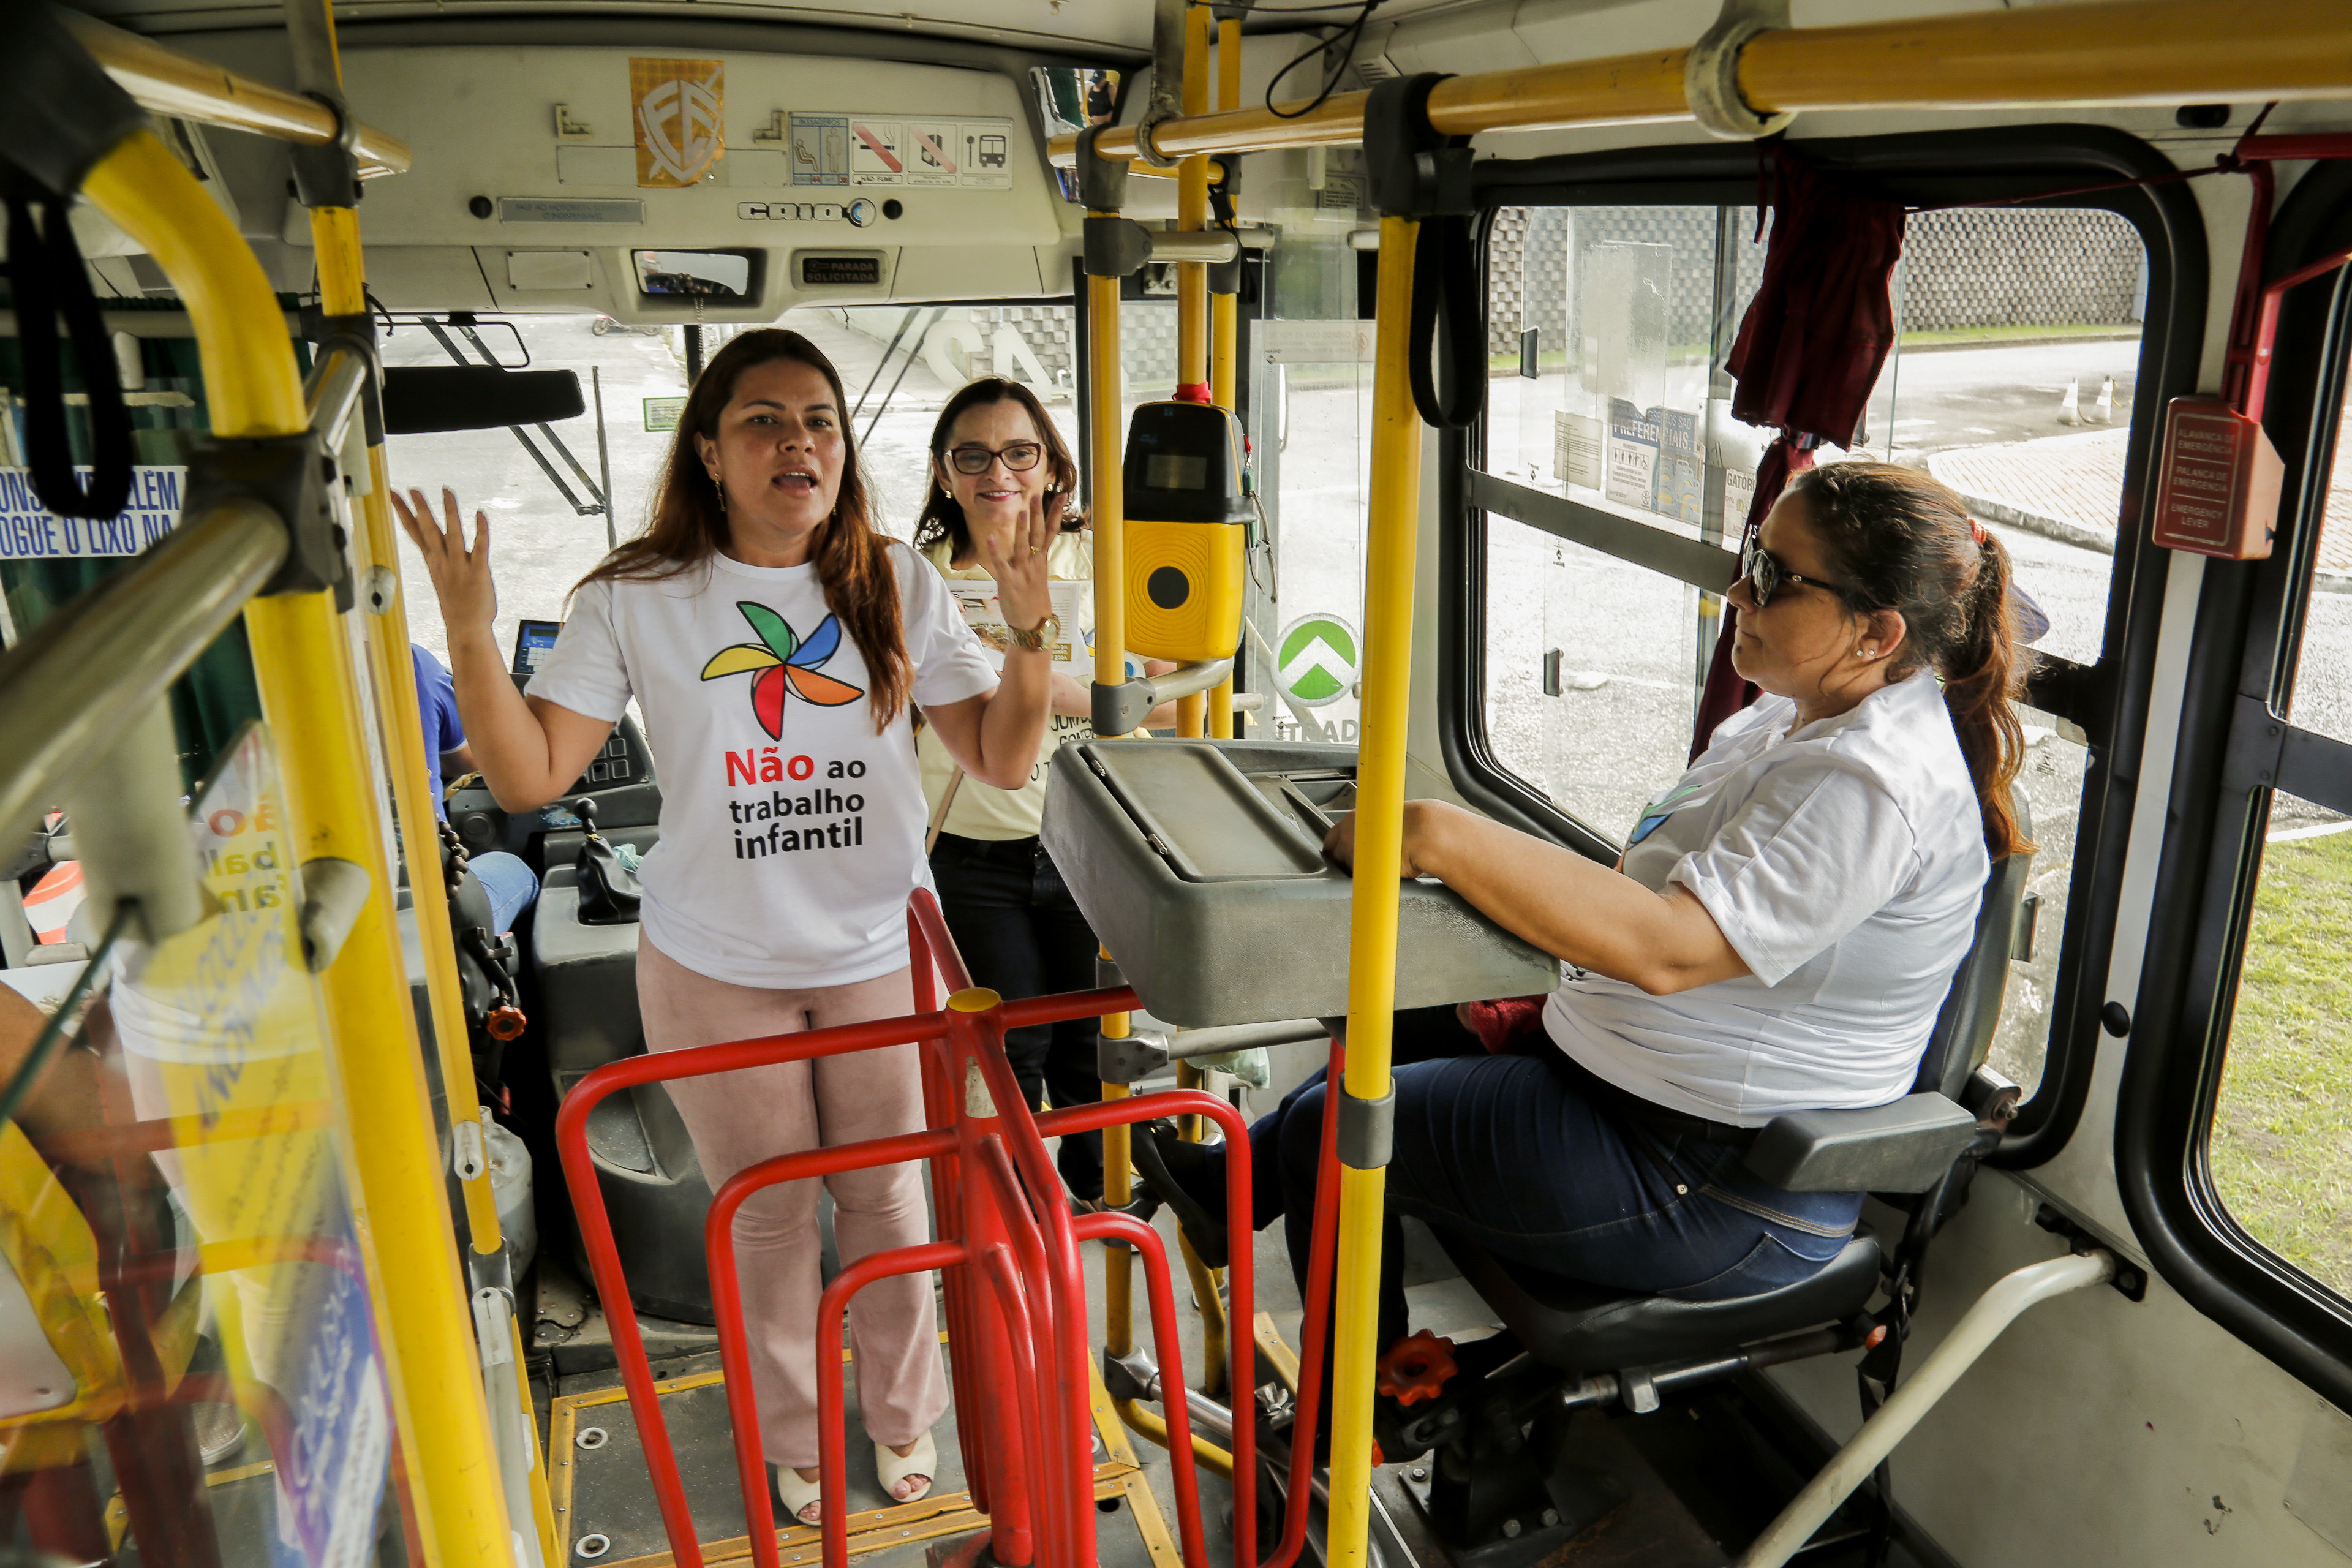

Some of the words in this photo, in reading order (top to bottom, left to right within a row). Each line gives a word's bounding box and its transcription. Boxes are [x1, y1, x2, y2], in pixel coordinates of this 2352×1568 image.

[831, 262, 875, 271] PARADA
[1678, 415, 1692, 431] SÃO
[2177, 429, 2222, 442] ALAVANCA
[2224, 434, 2236, 443] DE
[2178, 440, 2233, 455] EMERGÊNCIA
[2176, 466, 2215, 480] PALANCA
[2216, 472, 2228, 481] DE
[2174, 477, 2228, 492] EMERGENCIA
[2171, 505, 2223, 519] EMERGENCY
[2182, 518, 2209, 529] LEVER
[0, 515, 59, 556] OGUE
[87, 514, 137, 554] LIXO
[725, 746, 815, 787] Não
[827, 760, 866, 779] ao
[729, 788, 865, 824] trabalho
[734, 816, 863, 859] infantil
